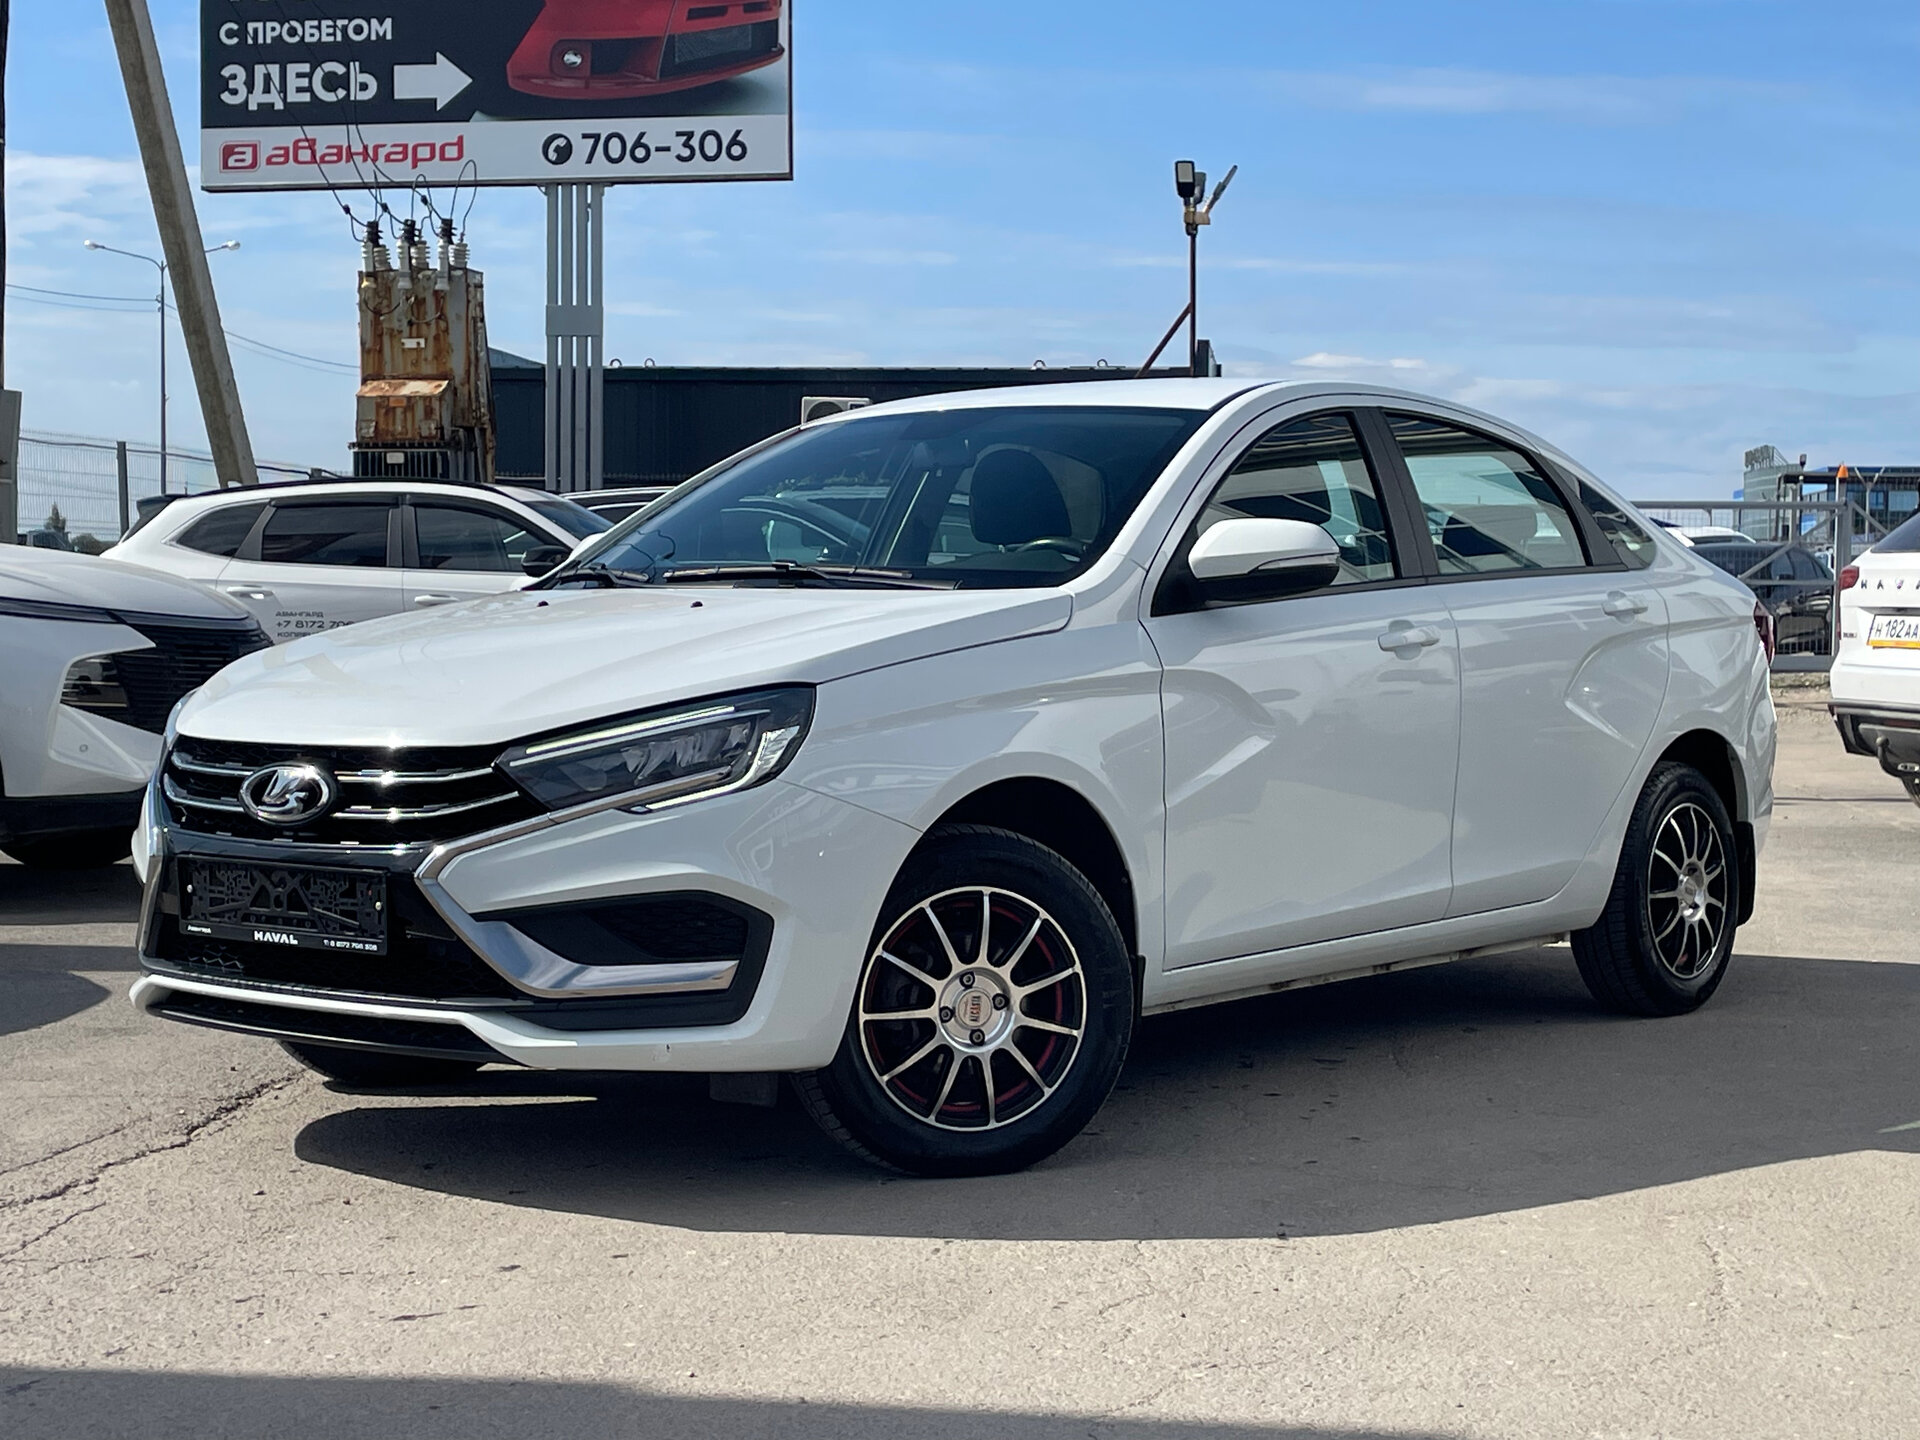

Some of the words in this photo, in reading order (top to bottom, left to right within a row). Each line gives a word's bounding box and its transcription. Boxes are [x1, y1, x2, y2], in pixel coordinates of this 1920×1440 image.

[219, 22, 239, 45] С
[247, 17, 393, 45] ПРОБЕГОМ
[219, 61, 378, 111] ЗДЕСЬ
[581, 130, 749, 164] 706-306
[276, 620, 291, 629] +7
[295, 620, 325, 629] 8172
[254, 931, 298, 945] HAVAL
